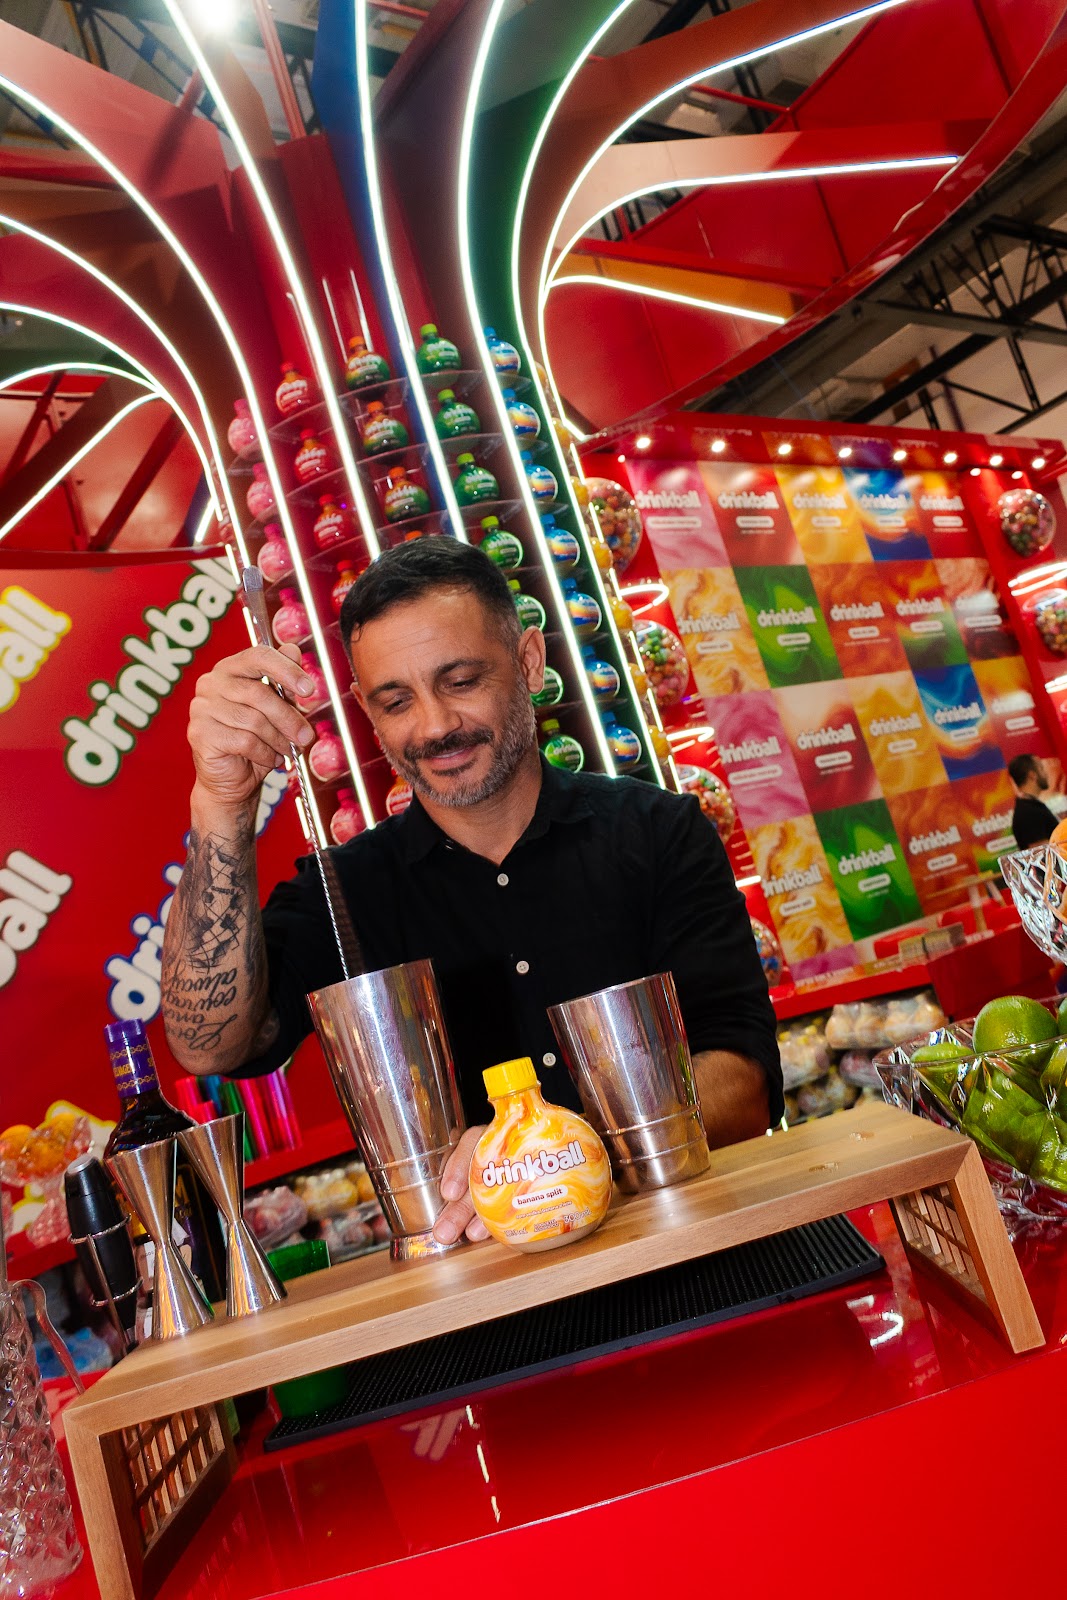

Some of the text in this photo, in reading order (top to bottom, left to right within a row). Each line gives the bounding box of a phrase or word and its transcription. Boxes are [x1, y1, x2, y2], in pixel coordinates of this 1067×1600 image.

[757, 606, 817, 628] drinkball
[797, 723, 856, 750] drinkball
[869, 712, 922, 737] drinkball
[908, 825, 962, 855] drinkball
[838, 843, 897, 875] drinkball
[482, 1140, 586, 1188] drinkball
[517, 1188, 563, 1205] banana split
